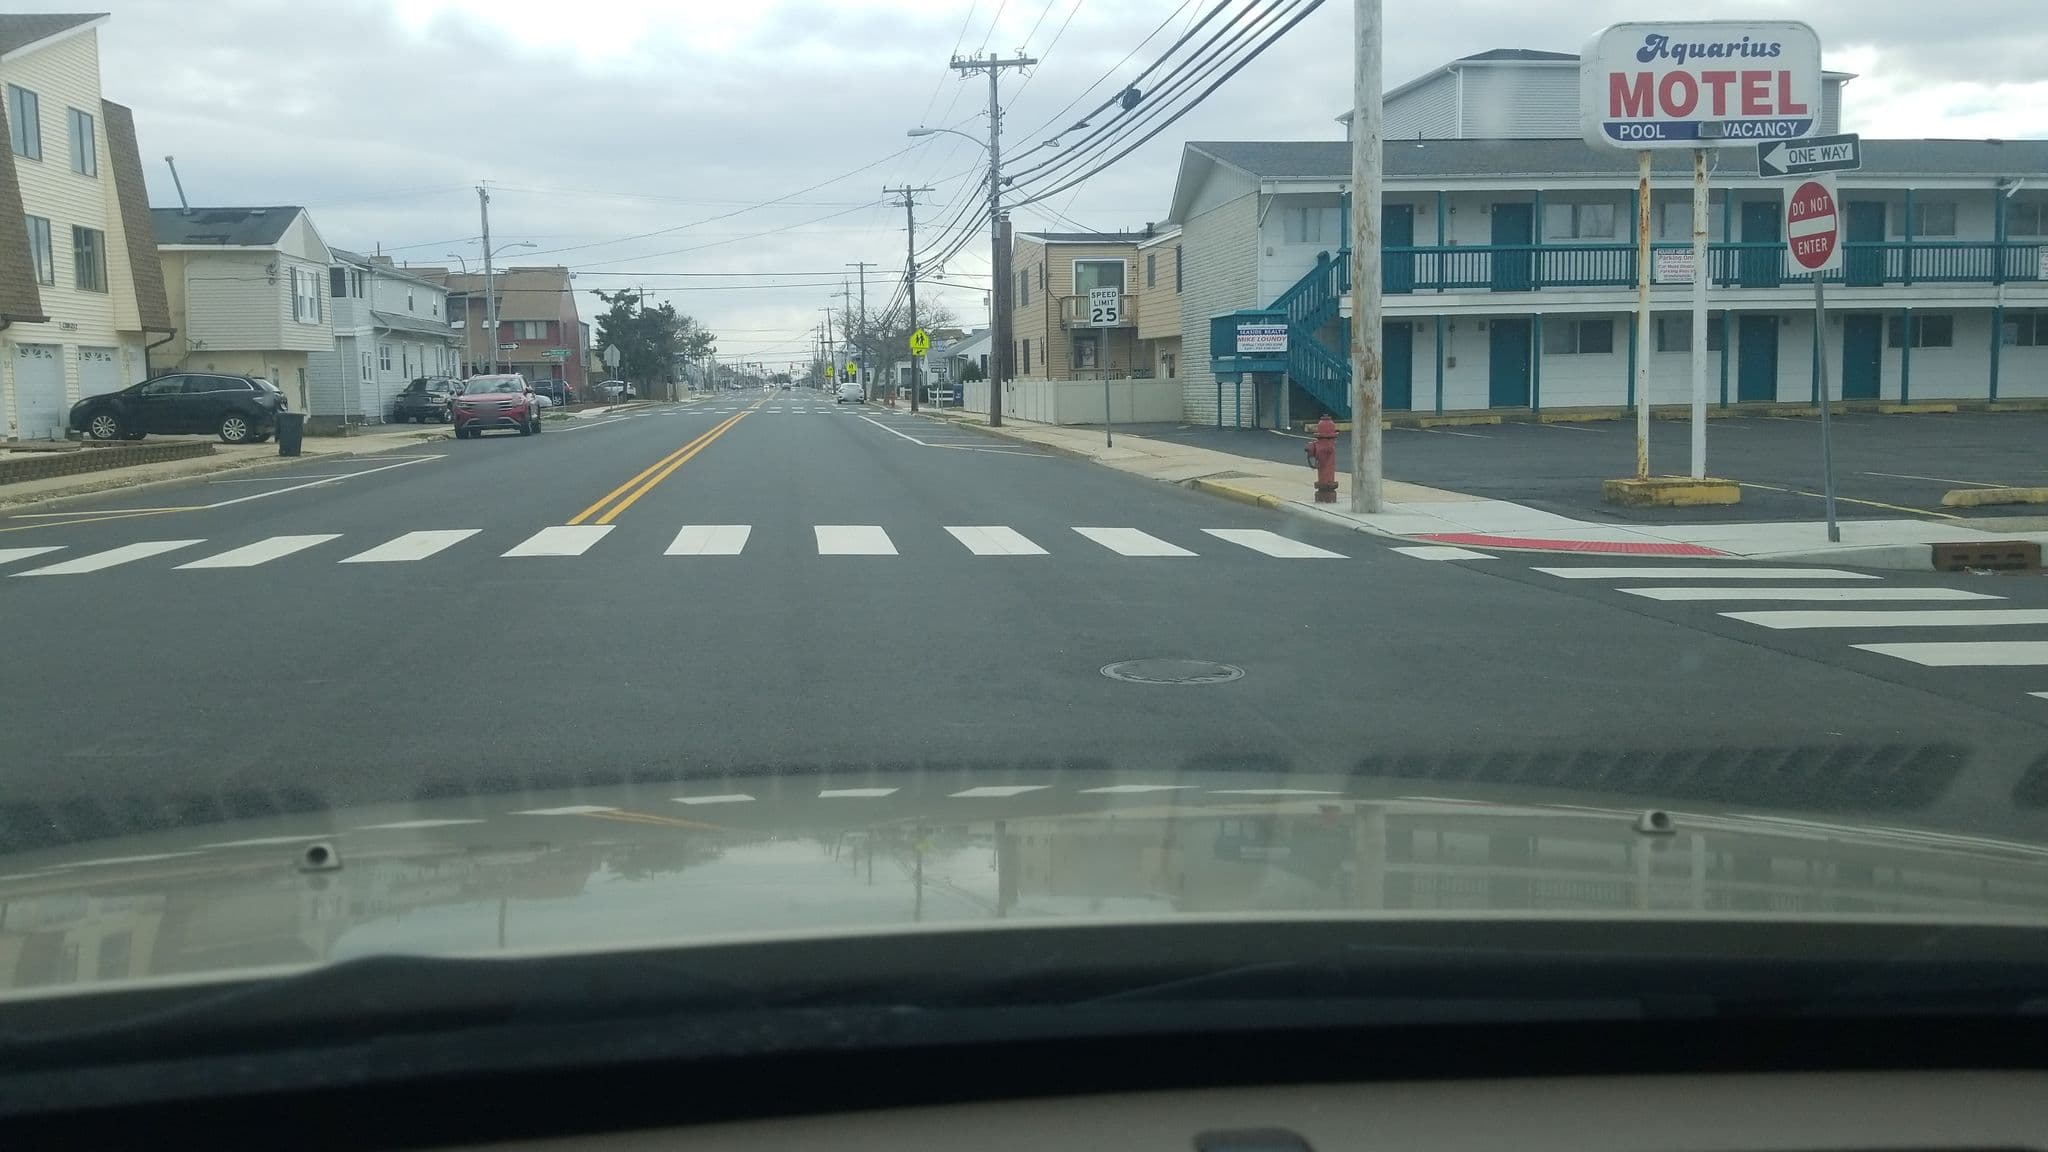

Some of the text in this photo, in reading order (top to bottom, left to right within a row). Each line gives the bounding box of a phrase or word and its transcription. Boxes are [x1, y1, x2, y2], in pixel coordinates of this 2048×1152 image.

[1636, 33, 1781, 65] Aquarius
[1610, 70, 1807, 117] MOTEL
[1619, 124, 1666, 139] POOL
[1722, 121, 1798, 137] VACANCY
[1789, 145, 1849, 164] ONE WAY
[1792, 196, 1829, 216] DO NOT
[1798, 238, 1828, 256] ENTER
[1091, 291, 1117, 299] SPEED
[1092, 307, 1117, 322] 25
